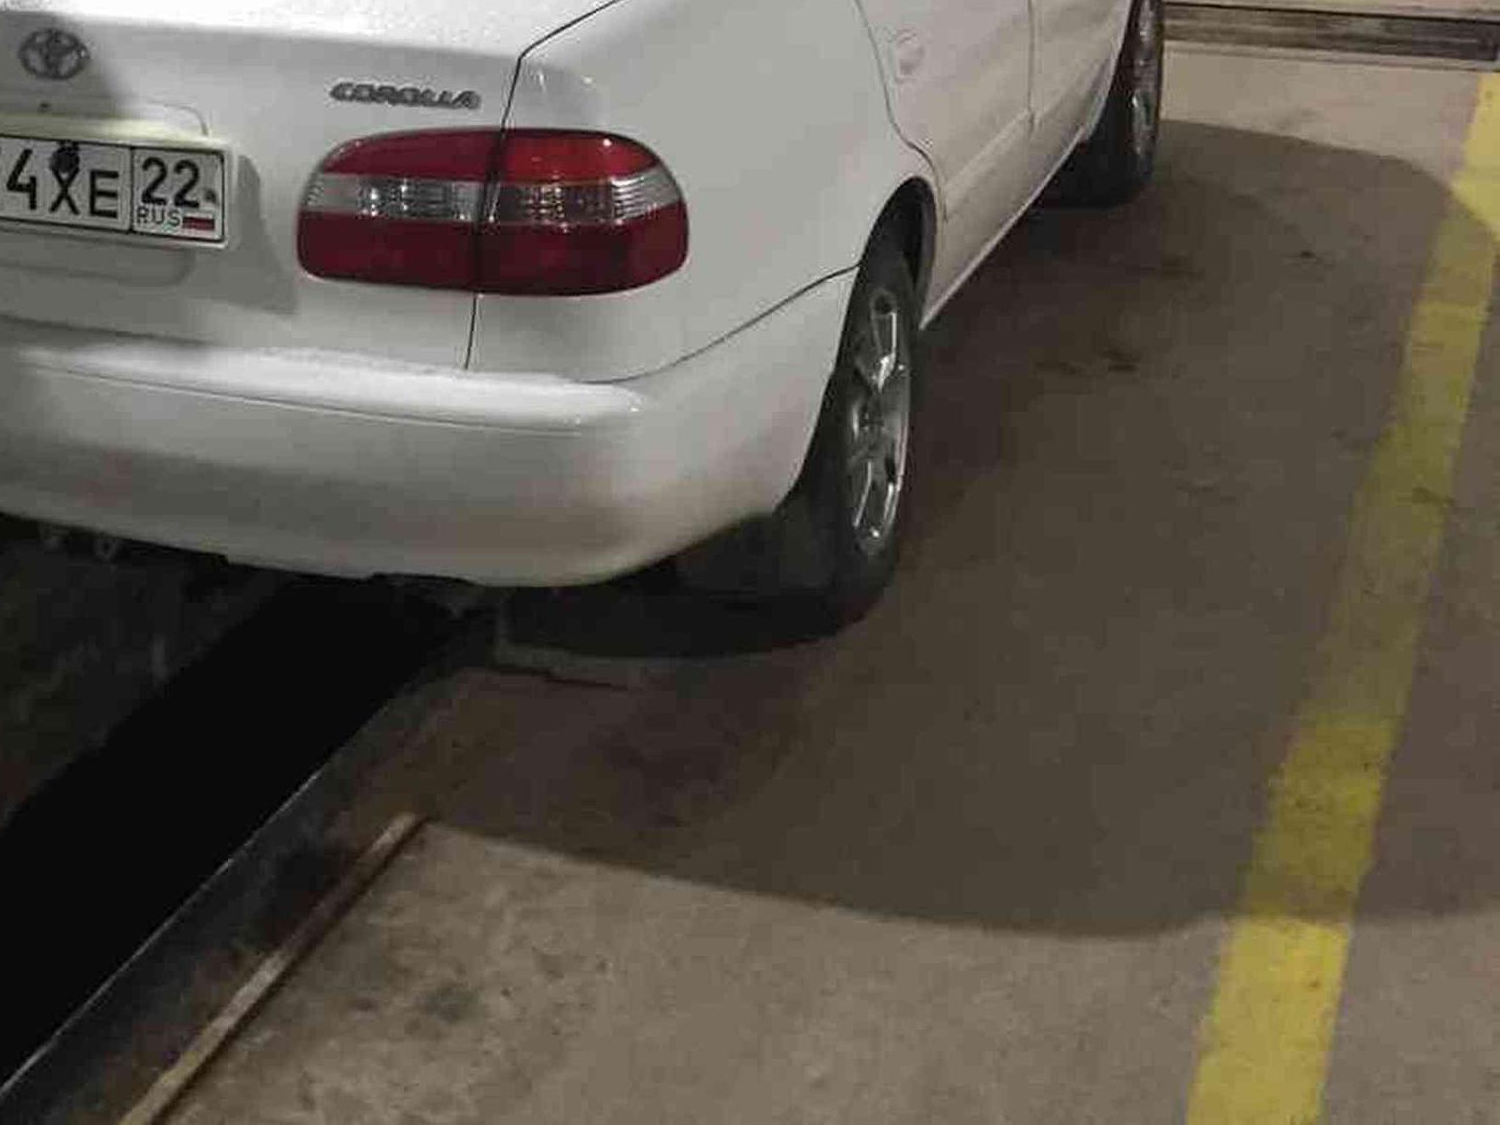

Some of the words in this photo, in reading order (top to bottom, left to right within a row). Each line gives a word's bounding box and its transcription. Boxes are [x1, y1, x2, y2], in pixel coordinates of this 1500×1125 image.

[329, 82, 482, 111] COROLLA
[141, 156, 200, 209] 22
[136, 204, 181, 227] RUS
